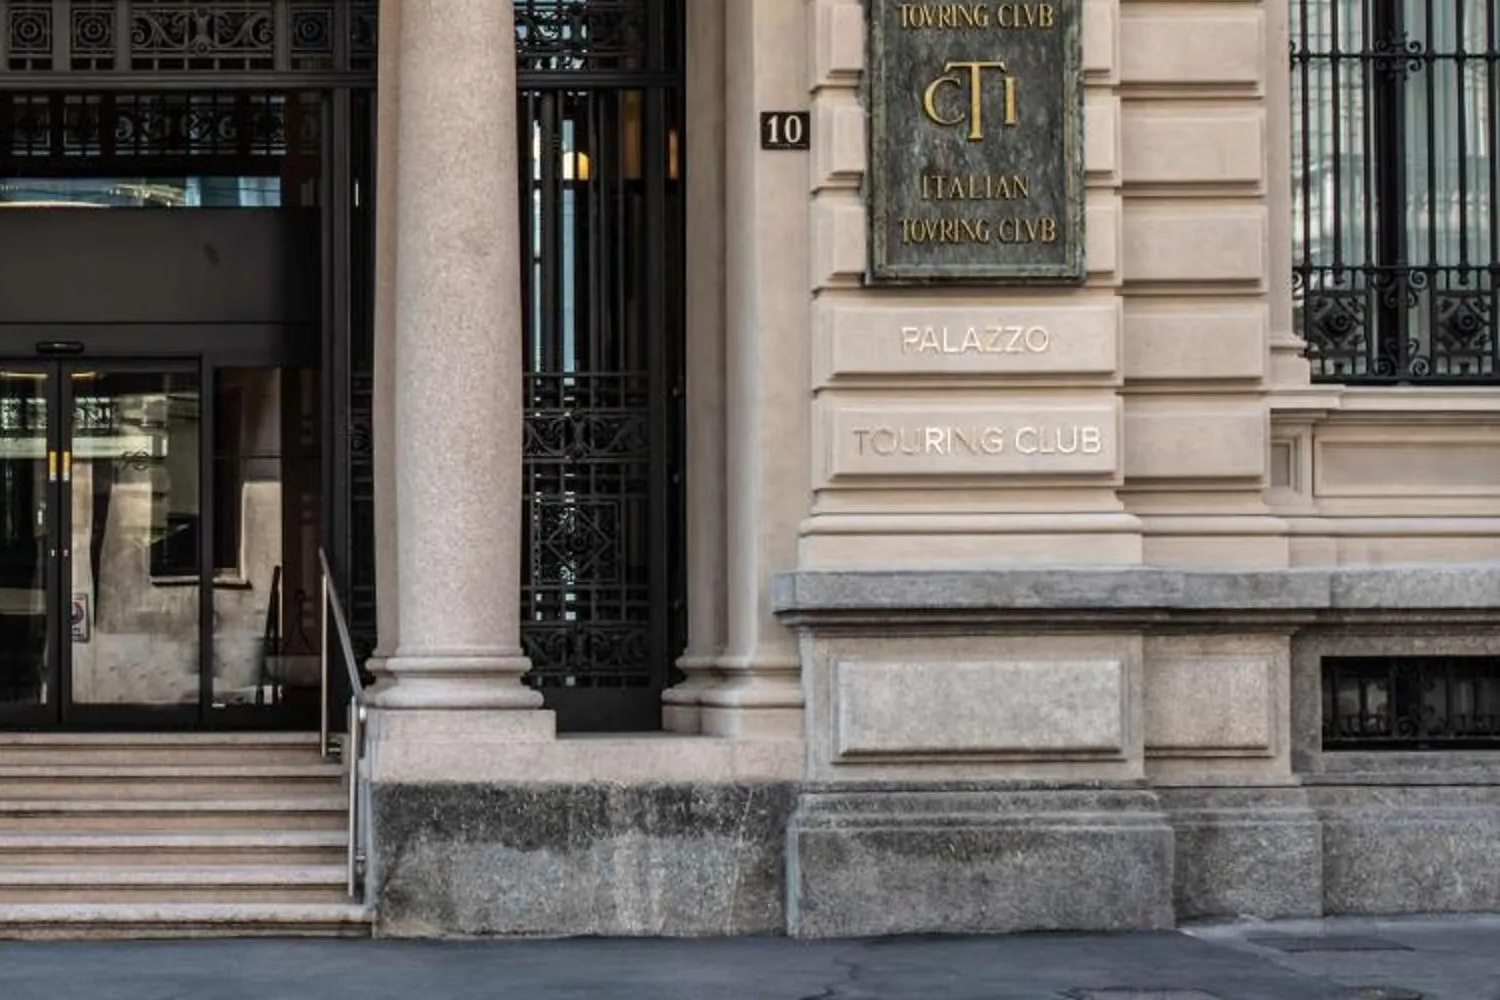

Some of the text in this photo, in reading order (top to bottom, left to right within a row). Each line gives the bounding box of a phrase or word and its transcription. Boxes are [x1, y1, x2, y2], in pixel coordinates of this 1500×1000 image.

[767, 115, 803, 143] 10
[921, 174, 1030, 200] ITALIAN
[901, 325, 1050, 354] PALAZZO
[852, 425, 1102, 455] TOURING CLUB
